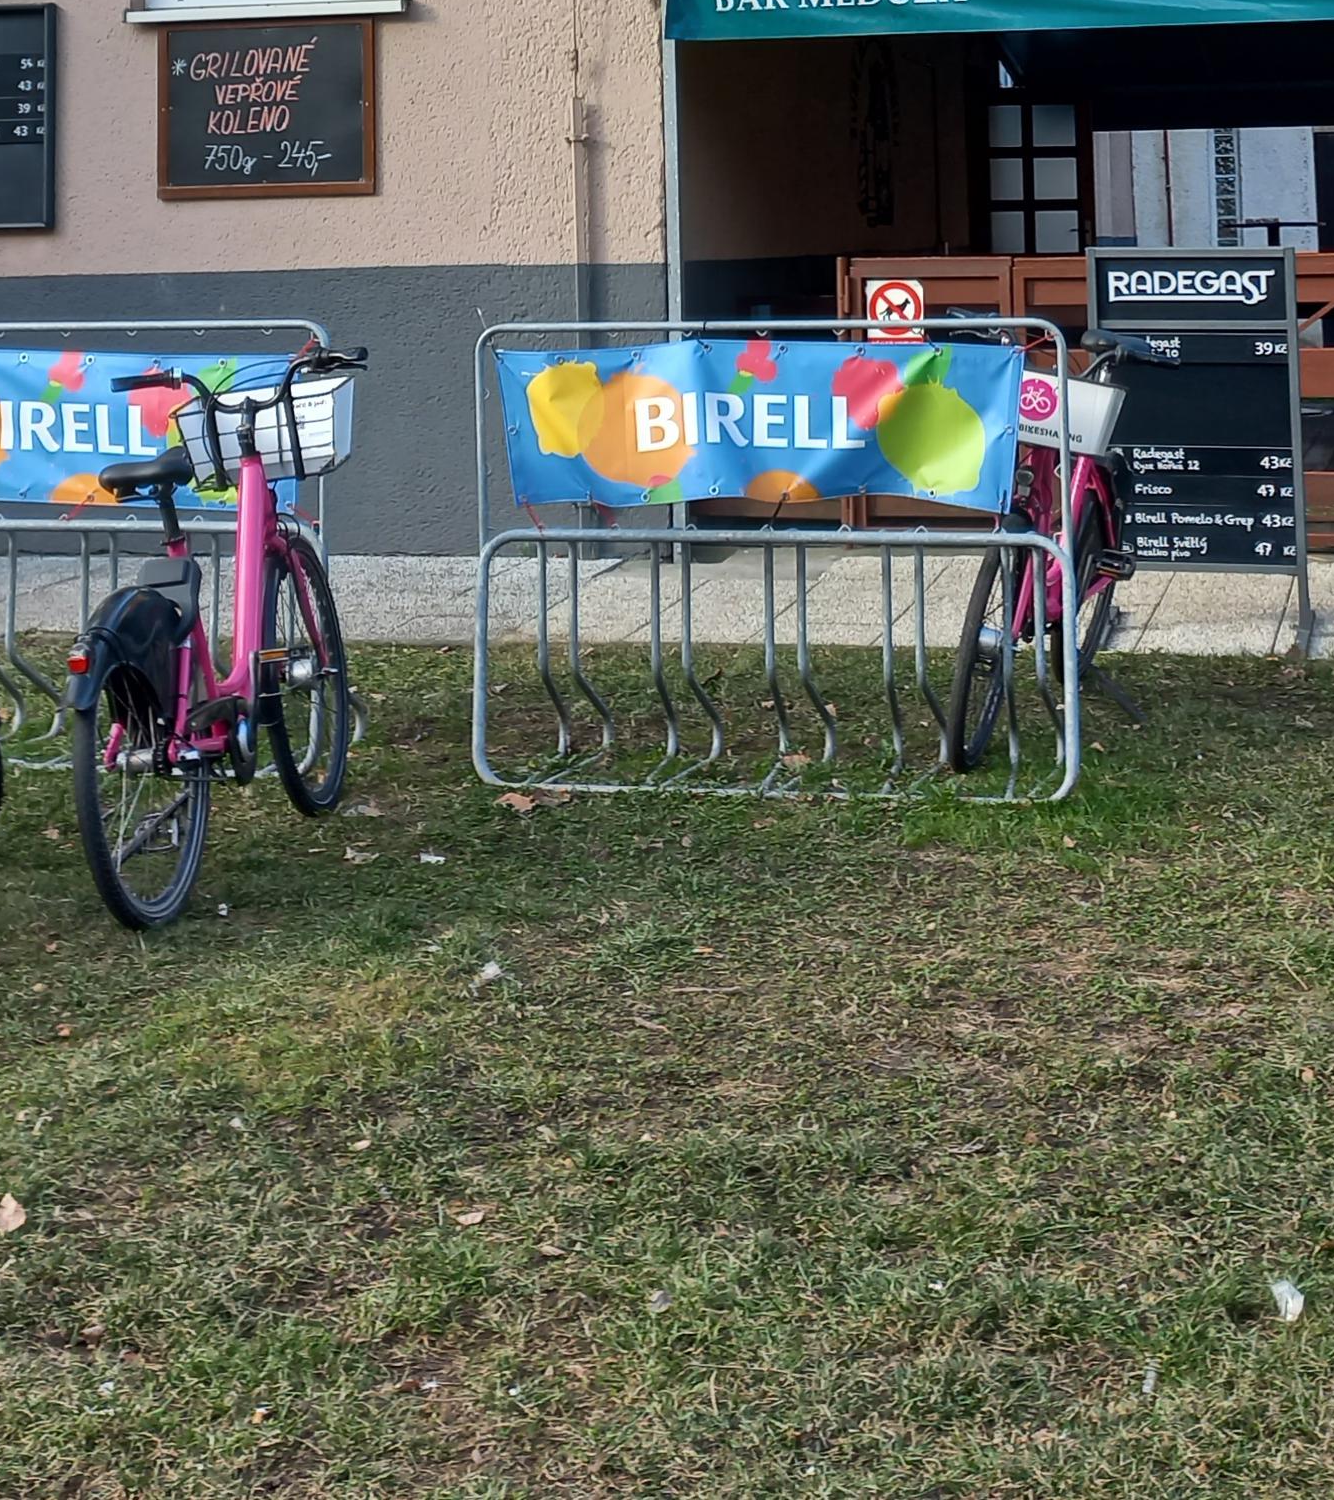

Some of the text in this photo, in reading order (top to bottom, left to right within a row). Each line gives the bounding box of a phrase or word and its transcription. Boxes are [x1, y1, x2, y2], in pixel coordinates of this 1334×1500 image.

[190, 36, 318, 82] GRILOVANÉ
[17, 80, 32, 91] 43
[215, 75, 303, 105] VEPŘOVÉ
[17, 103, 31, 114] 39
[207, 105, 290, 135] KOLENO
[13, 125, 28, 136] 43
[204, 144, 258, 175] 750g
[1108, 269, 1275, 305] RADEGAST
[1146, 335, 1181, 352] egast
[1254, 341, 1273, 356] 39
[635, 391, 867, 454] BIRELL
[1019, 424, 1083, 443] BIKESHANG
[1133, 447, 1185, 463] Radegast
[1259, 456, 1278, 470] 43
[1187, 460, 1200, 471] 12
[1134, 483, 1173, 495] Frisco
[1257, 484, 1275, 497] 47
[1134, 512, 1167, 524] Birell
[1171, 512, 1213, 524] Pomelo
[1224, 514, 1255, 532] Grep
[1261, 514, 1280, 528] 43
[1136, 536, 1169, 548] Birell
[1254, 542, 1272, 556] 47
